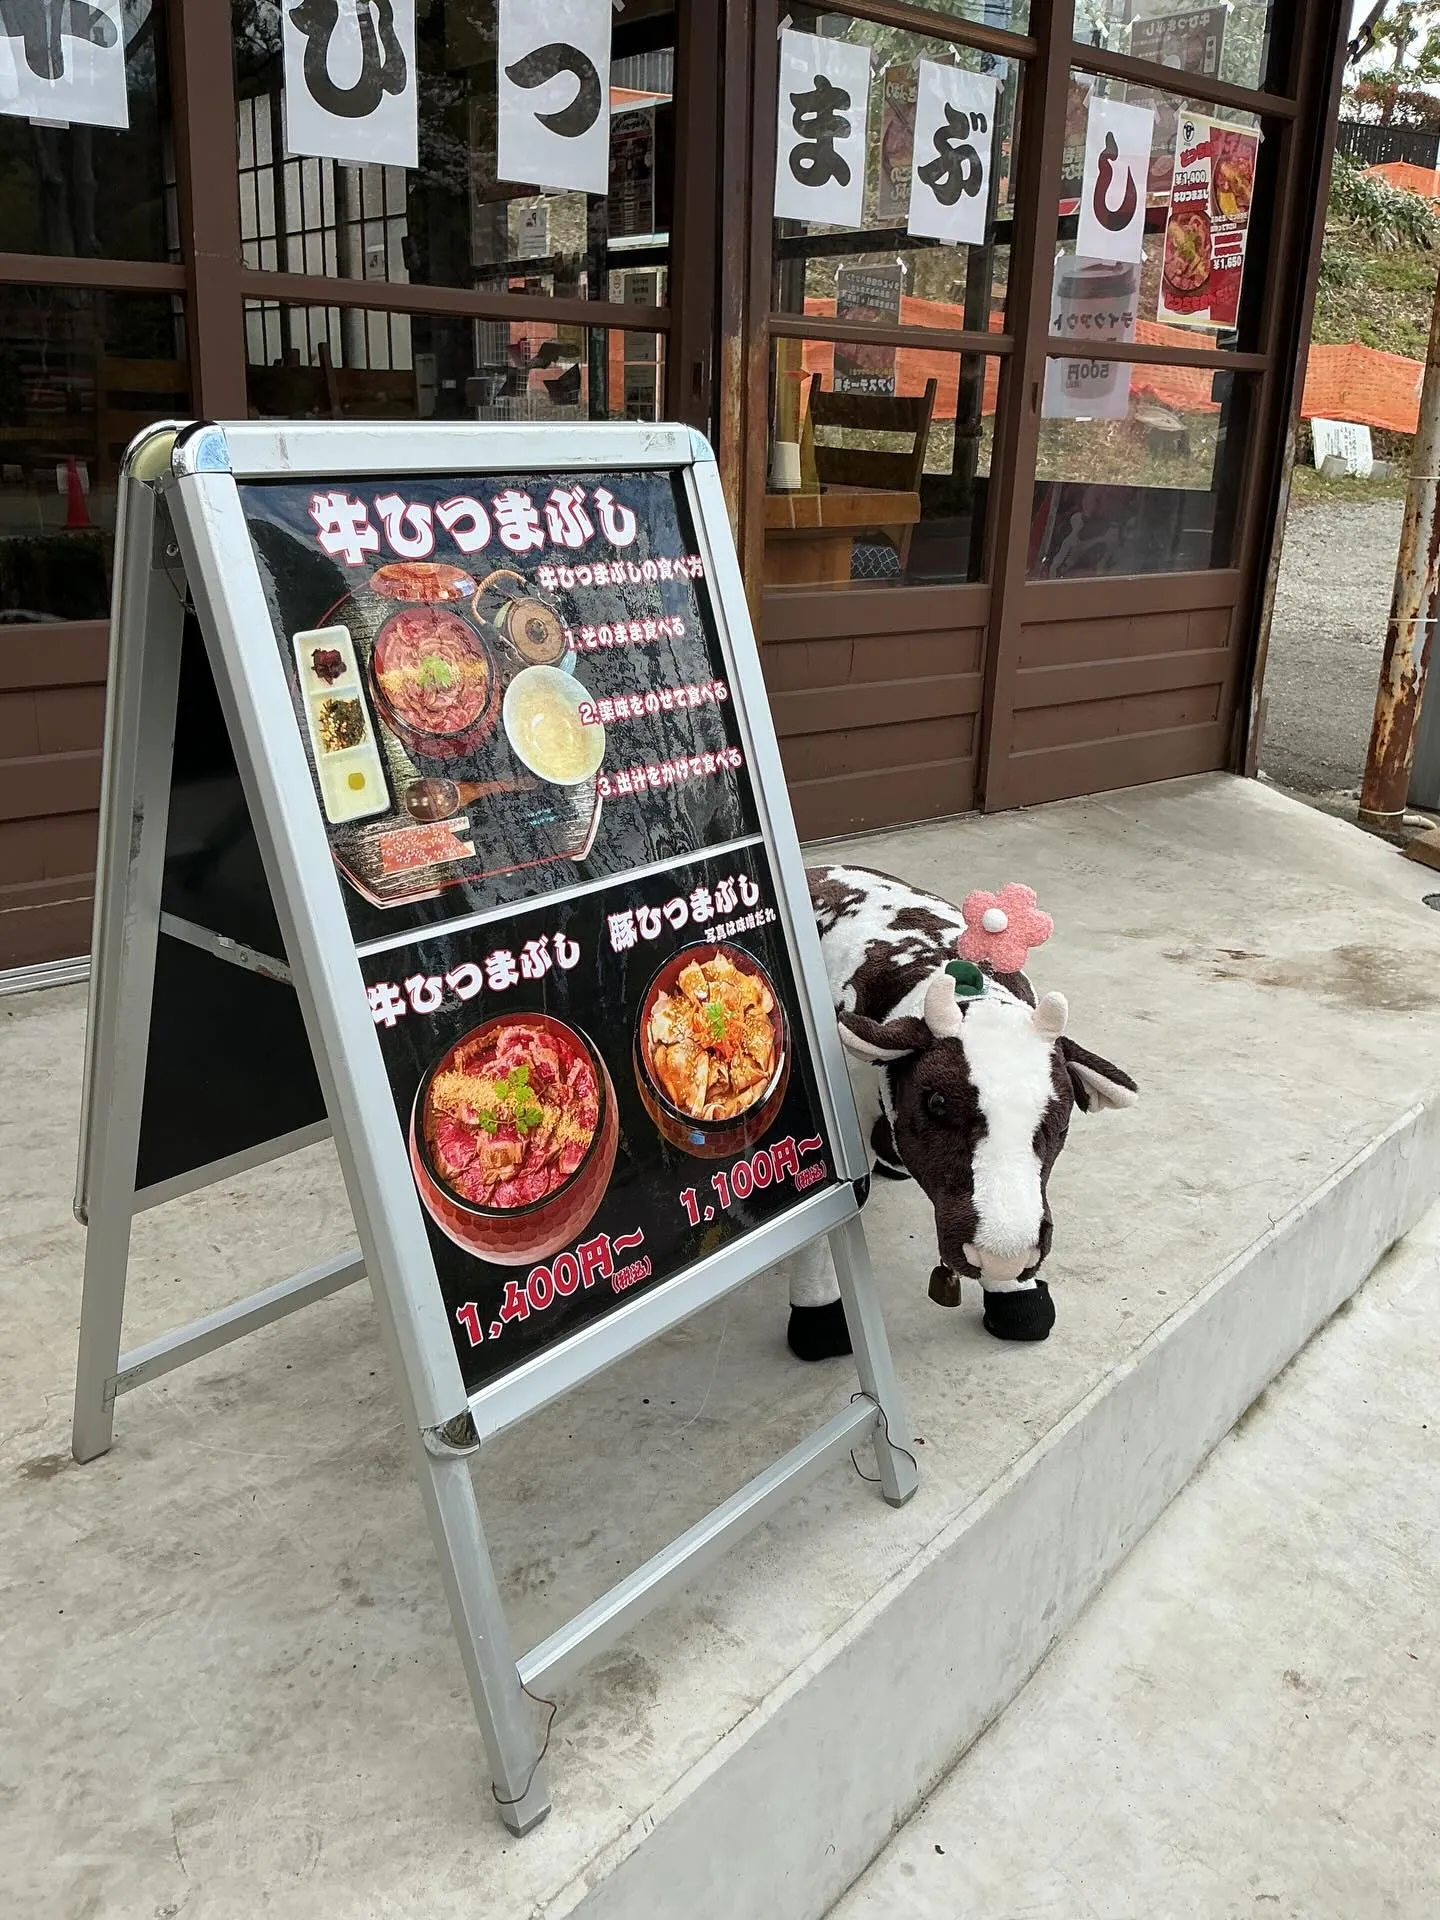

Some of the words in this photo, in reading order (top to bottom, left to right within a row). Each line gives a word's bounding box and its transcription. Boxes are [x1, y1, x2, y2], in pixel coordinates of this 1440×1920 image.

[505, 42, 602, 138] つ
[789, 74, 852, 188] ま
[918, 101, 988, 206] ぶ
[1093, 131, 1138, 232] し
[309, 485, 638, 566] 牛ひつまぶし
[537, 553, 704, 592] 牛ひつまぶしの食べ方
[607, 873, 760, 953] 豚ひつまぶし
[366, 931, 582, 1028] 牛ひつまぶし
